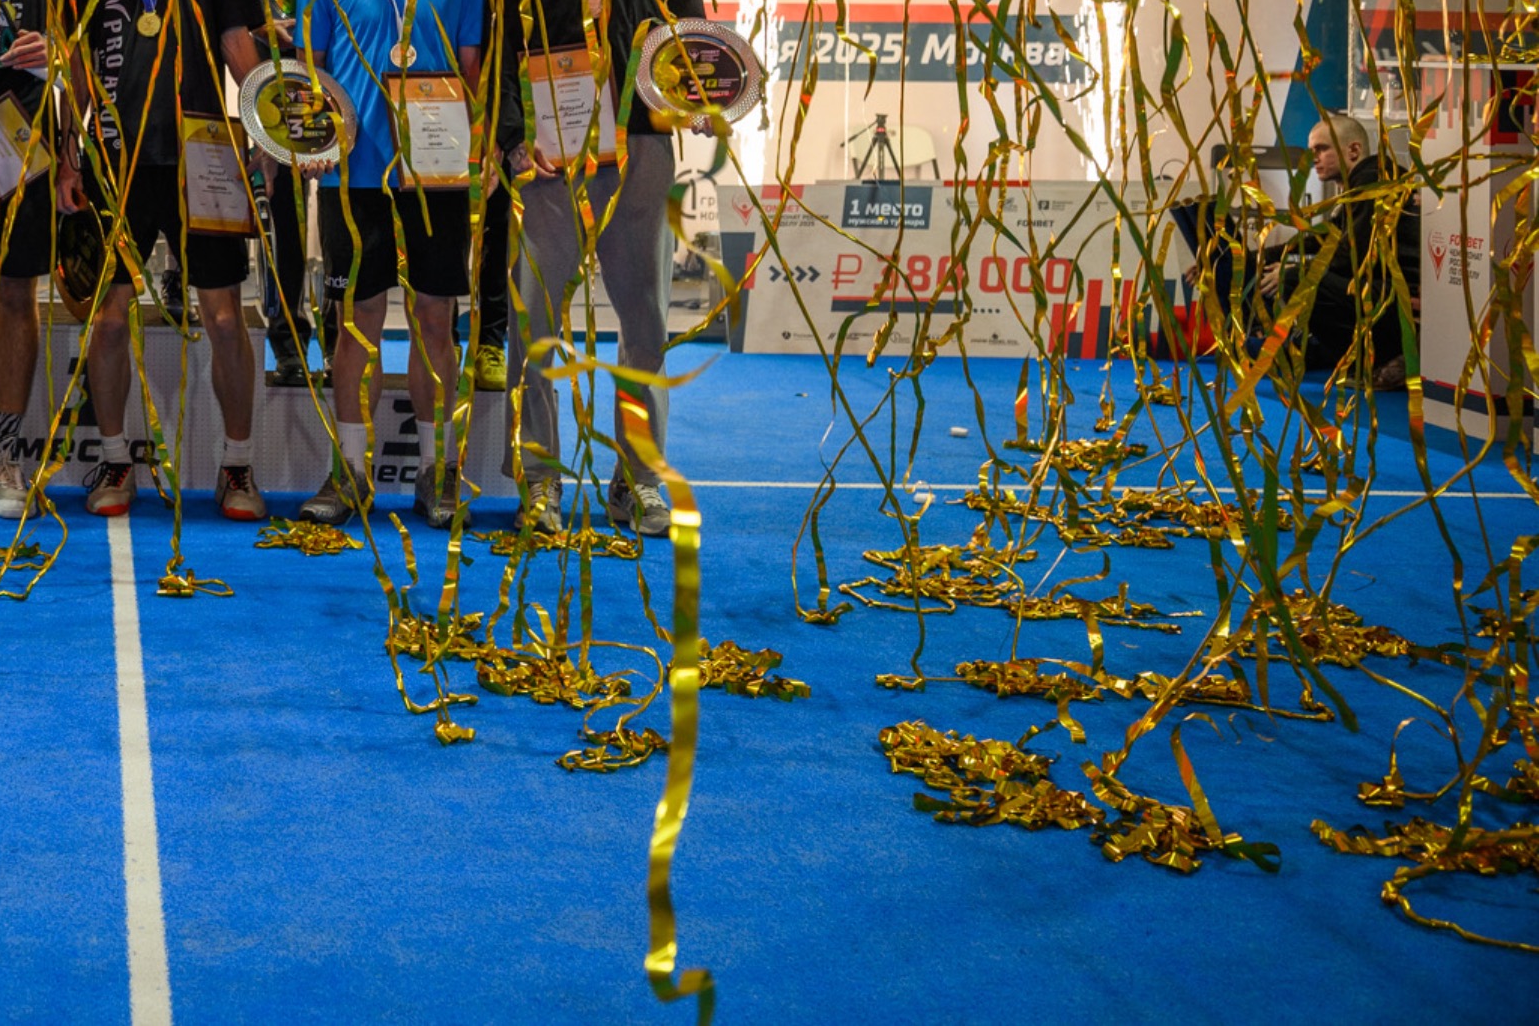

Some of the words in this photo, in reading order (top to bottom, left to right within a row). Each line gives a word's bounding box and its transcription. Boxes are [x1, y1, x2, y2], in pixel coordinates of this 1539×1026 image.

[103, 18, 123, 68] PRO
[920, 32, 1064, 65] Моква
[287, 118, 304, 139] 3
[850, 199, 861, 215] 1
[865, 202, 924, 216] место
[1449, 234, 1484, 249] FOBET
[873, 255, 964, 293] 380
[979, 256, 1075, 295] 000
